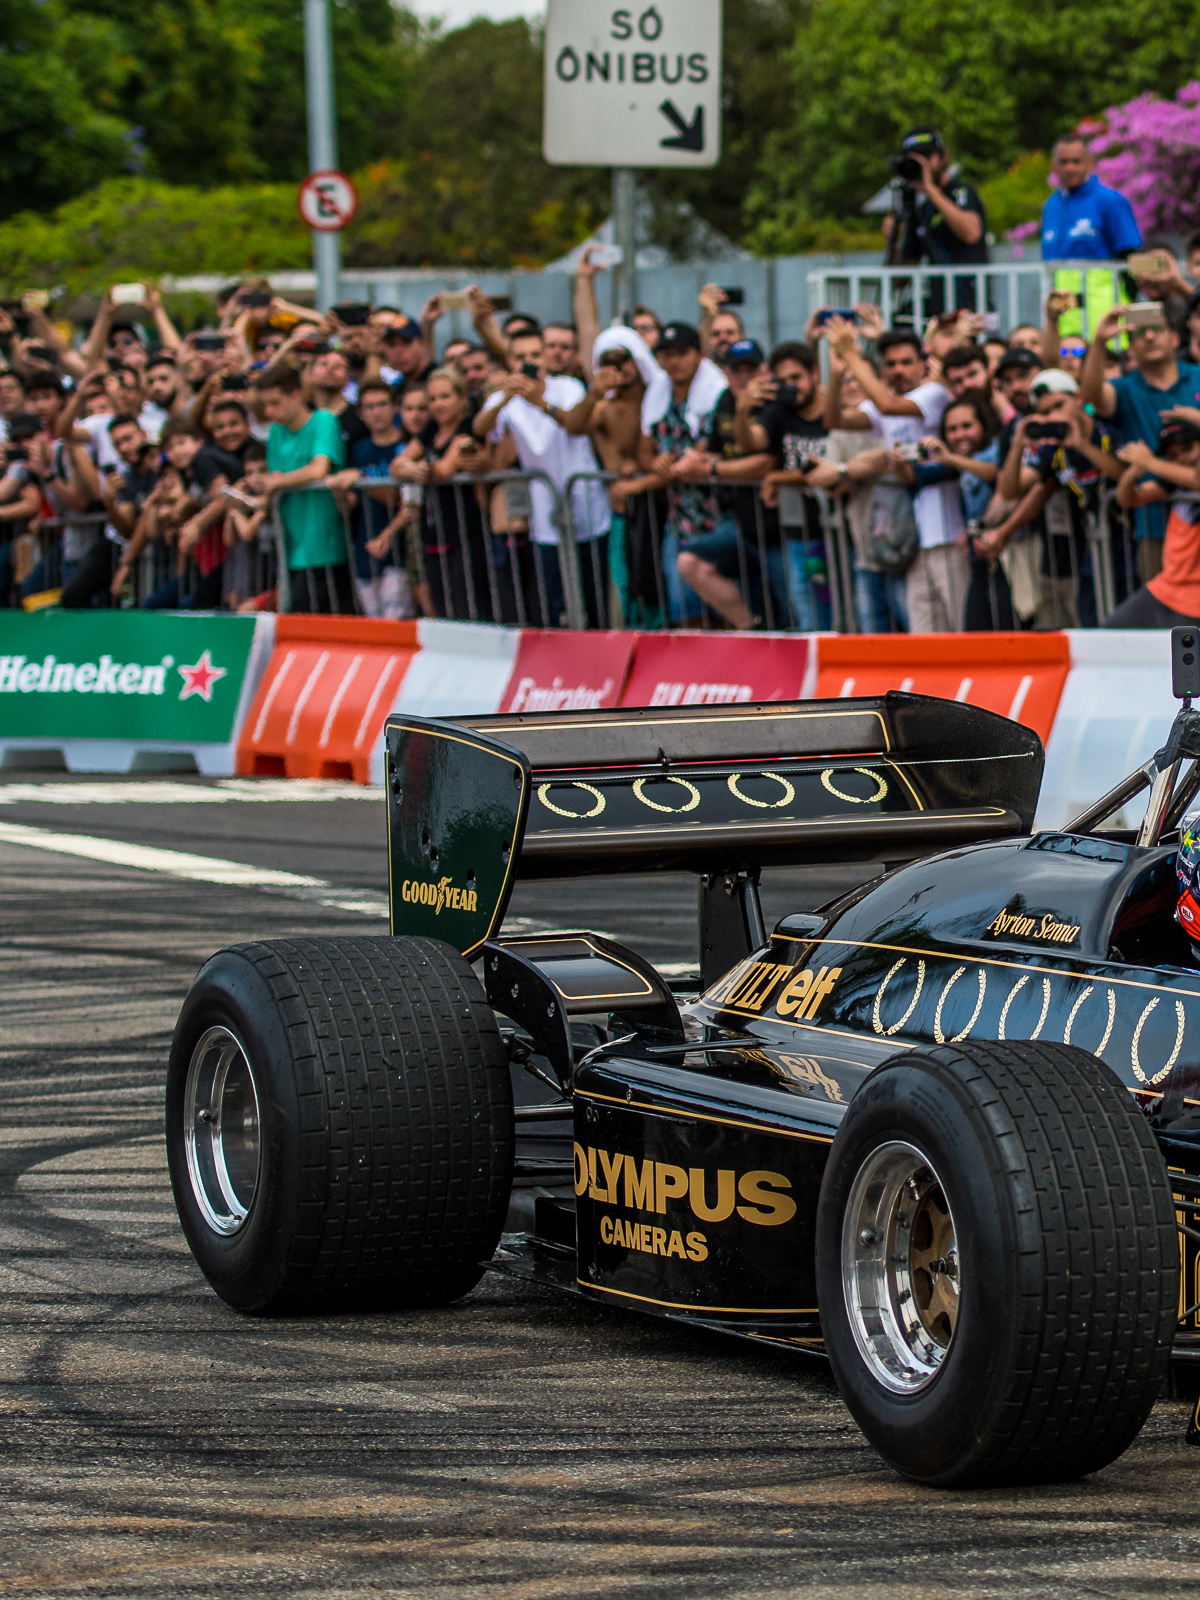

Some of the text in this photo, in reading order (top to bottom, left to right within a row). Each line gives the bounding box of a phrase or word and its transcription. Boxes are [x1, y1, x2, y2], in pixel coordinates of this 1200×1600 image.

[610, 6, 662, 41] SÓ
[556, 46, 709, 84] ÔNIBUS
[0, 654, 168, 695] Heineken
[402, 877, 478, 914] GOODYEAR
[986, 907, 1081, 943] Ayrton Senna
[776, 966, 843, 1021] elf
[573, 1142, 797, 1226] OLYMPUS
[600, 1216, 709, 1262] CAMERAS
